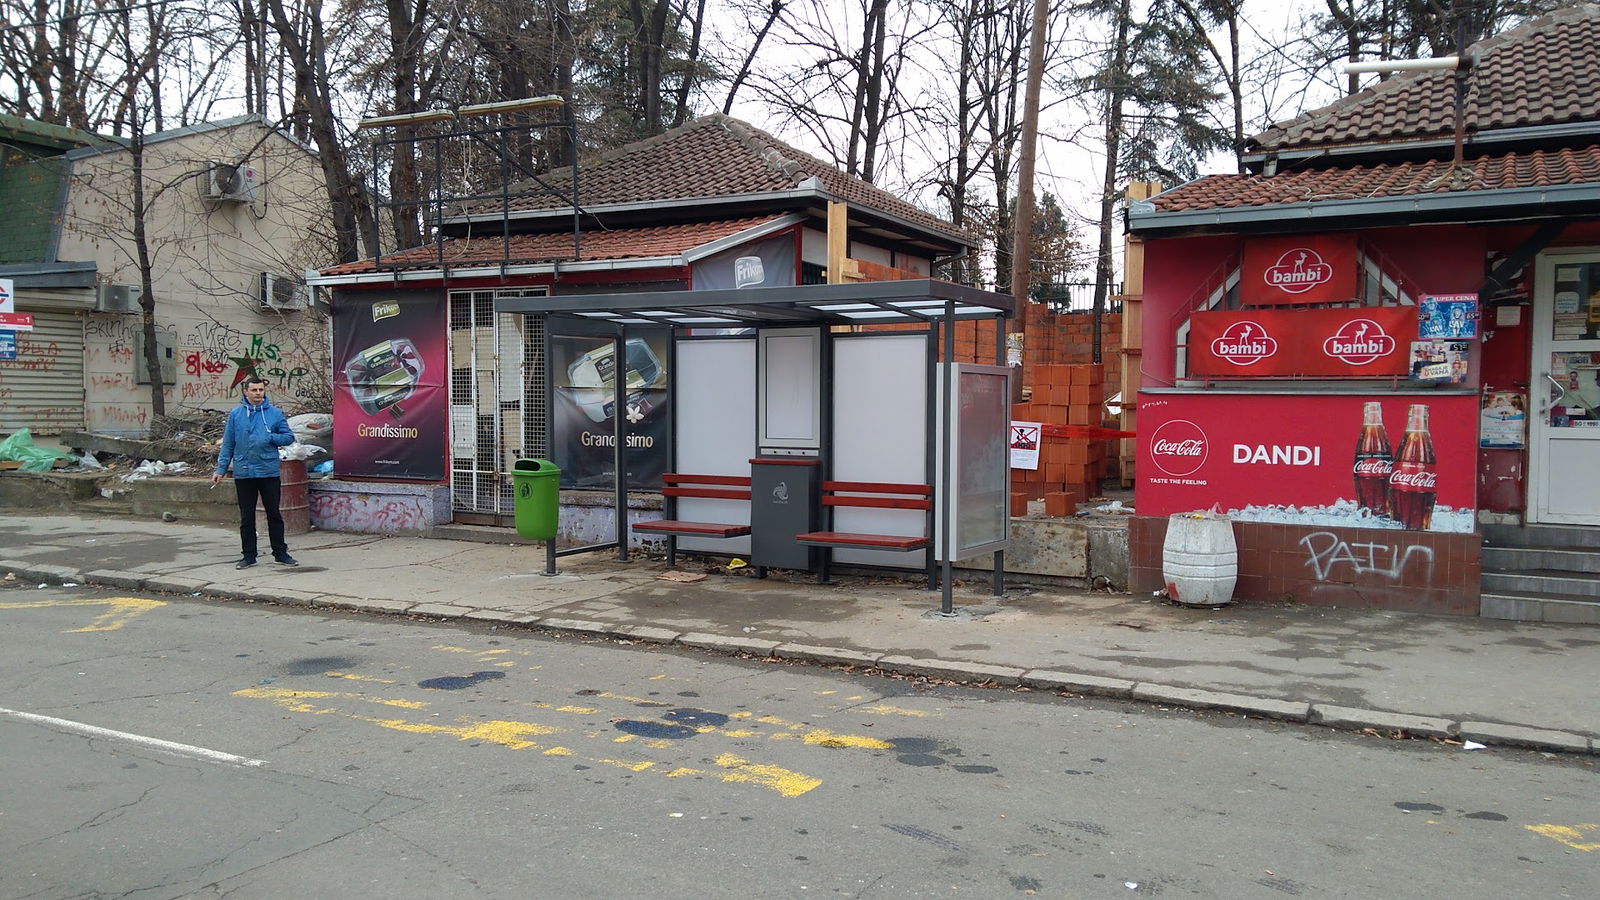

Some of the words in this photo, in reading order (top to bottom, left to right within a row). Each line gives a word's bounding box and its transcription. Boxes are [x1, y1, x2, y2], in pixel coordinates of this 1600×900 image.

[1272, 266, 1322, 284] bambi
[1219, 340, 1267, 355] bambi
[1332, 339, 1384, 355] bambi
[357, 423, 418, 439] Grandissimo
[1154, 438, 1205, 456] Coca-Cola
[1233, 444, 1321, 466] DANDI
[1353, 459, 1394, 474] Coca-Cola
[1389, 469, 1438, 488] Coca-Cola
